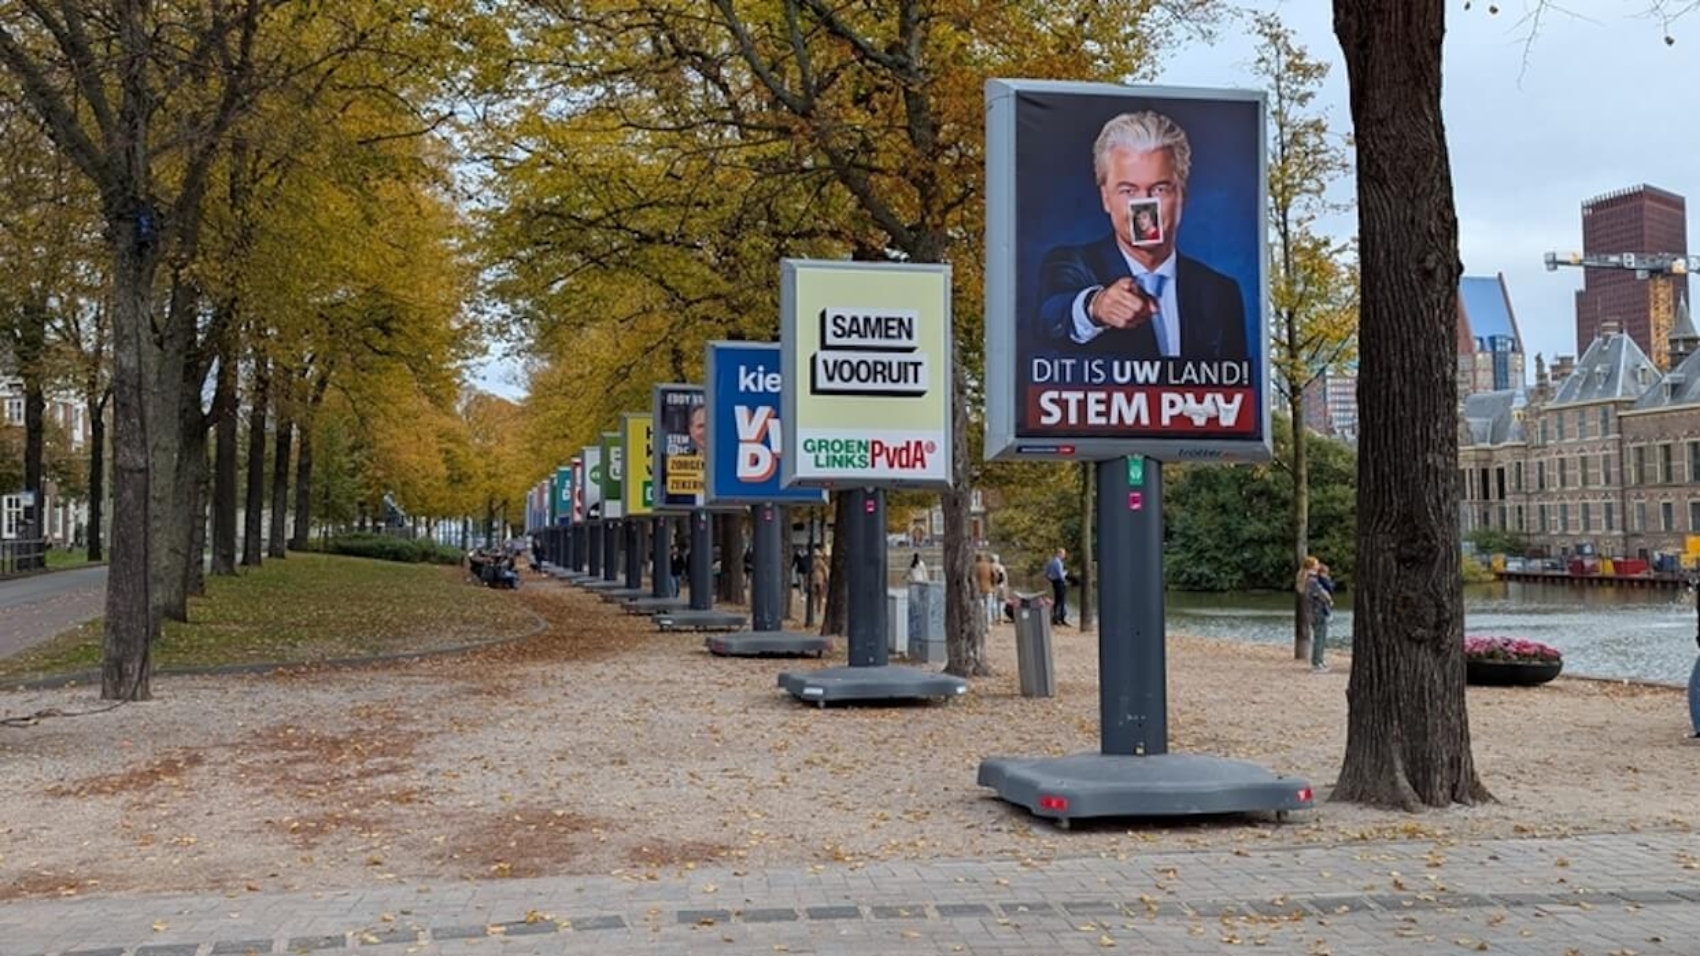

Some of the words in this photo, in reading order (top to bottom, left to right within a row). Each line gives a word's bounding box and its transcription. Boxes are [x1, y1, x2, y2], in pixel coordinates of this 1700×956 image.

[832, 315, 914, 341] SAMEN
[822, 359, 923, 384] VOORUIT
[1032, 358, 1076, 383] DIT
[1084, 359, 1106, 384] IS
[1112, 360, 1161, 385] UW
[1167, 362, 1250, 385] LAND!
[1039, 390, 1150, 426] STEM
[803, 438, 869, 454] GROEN
[870, 440, 927, 470] PvdA
[814, 454, 869, 469] LINKS
